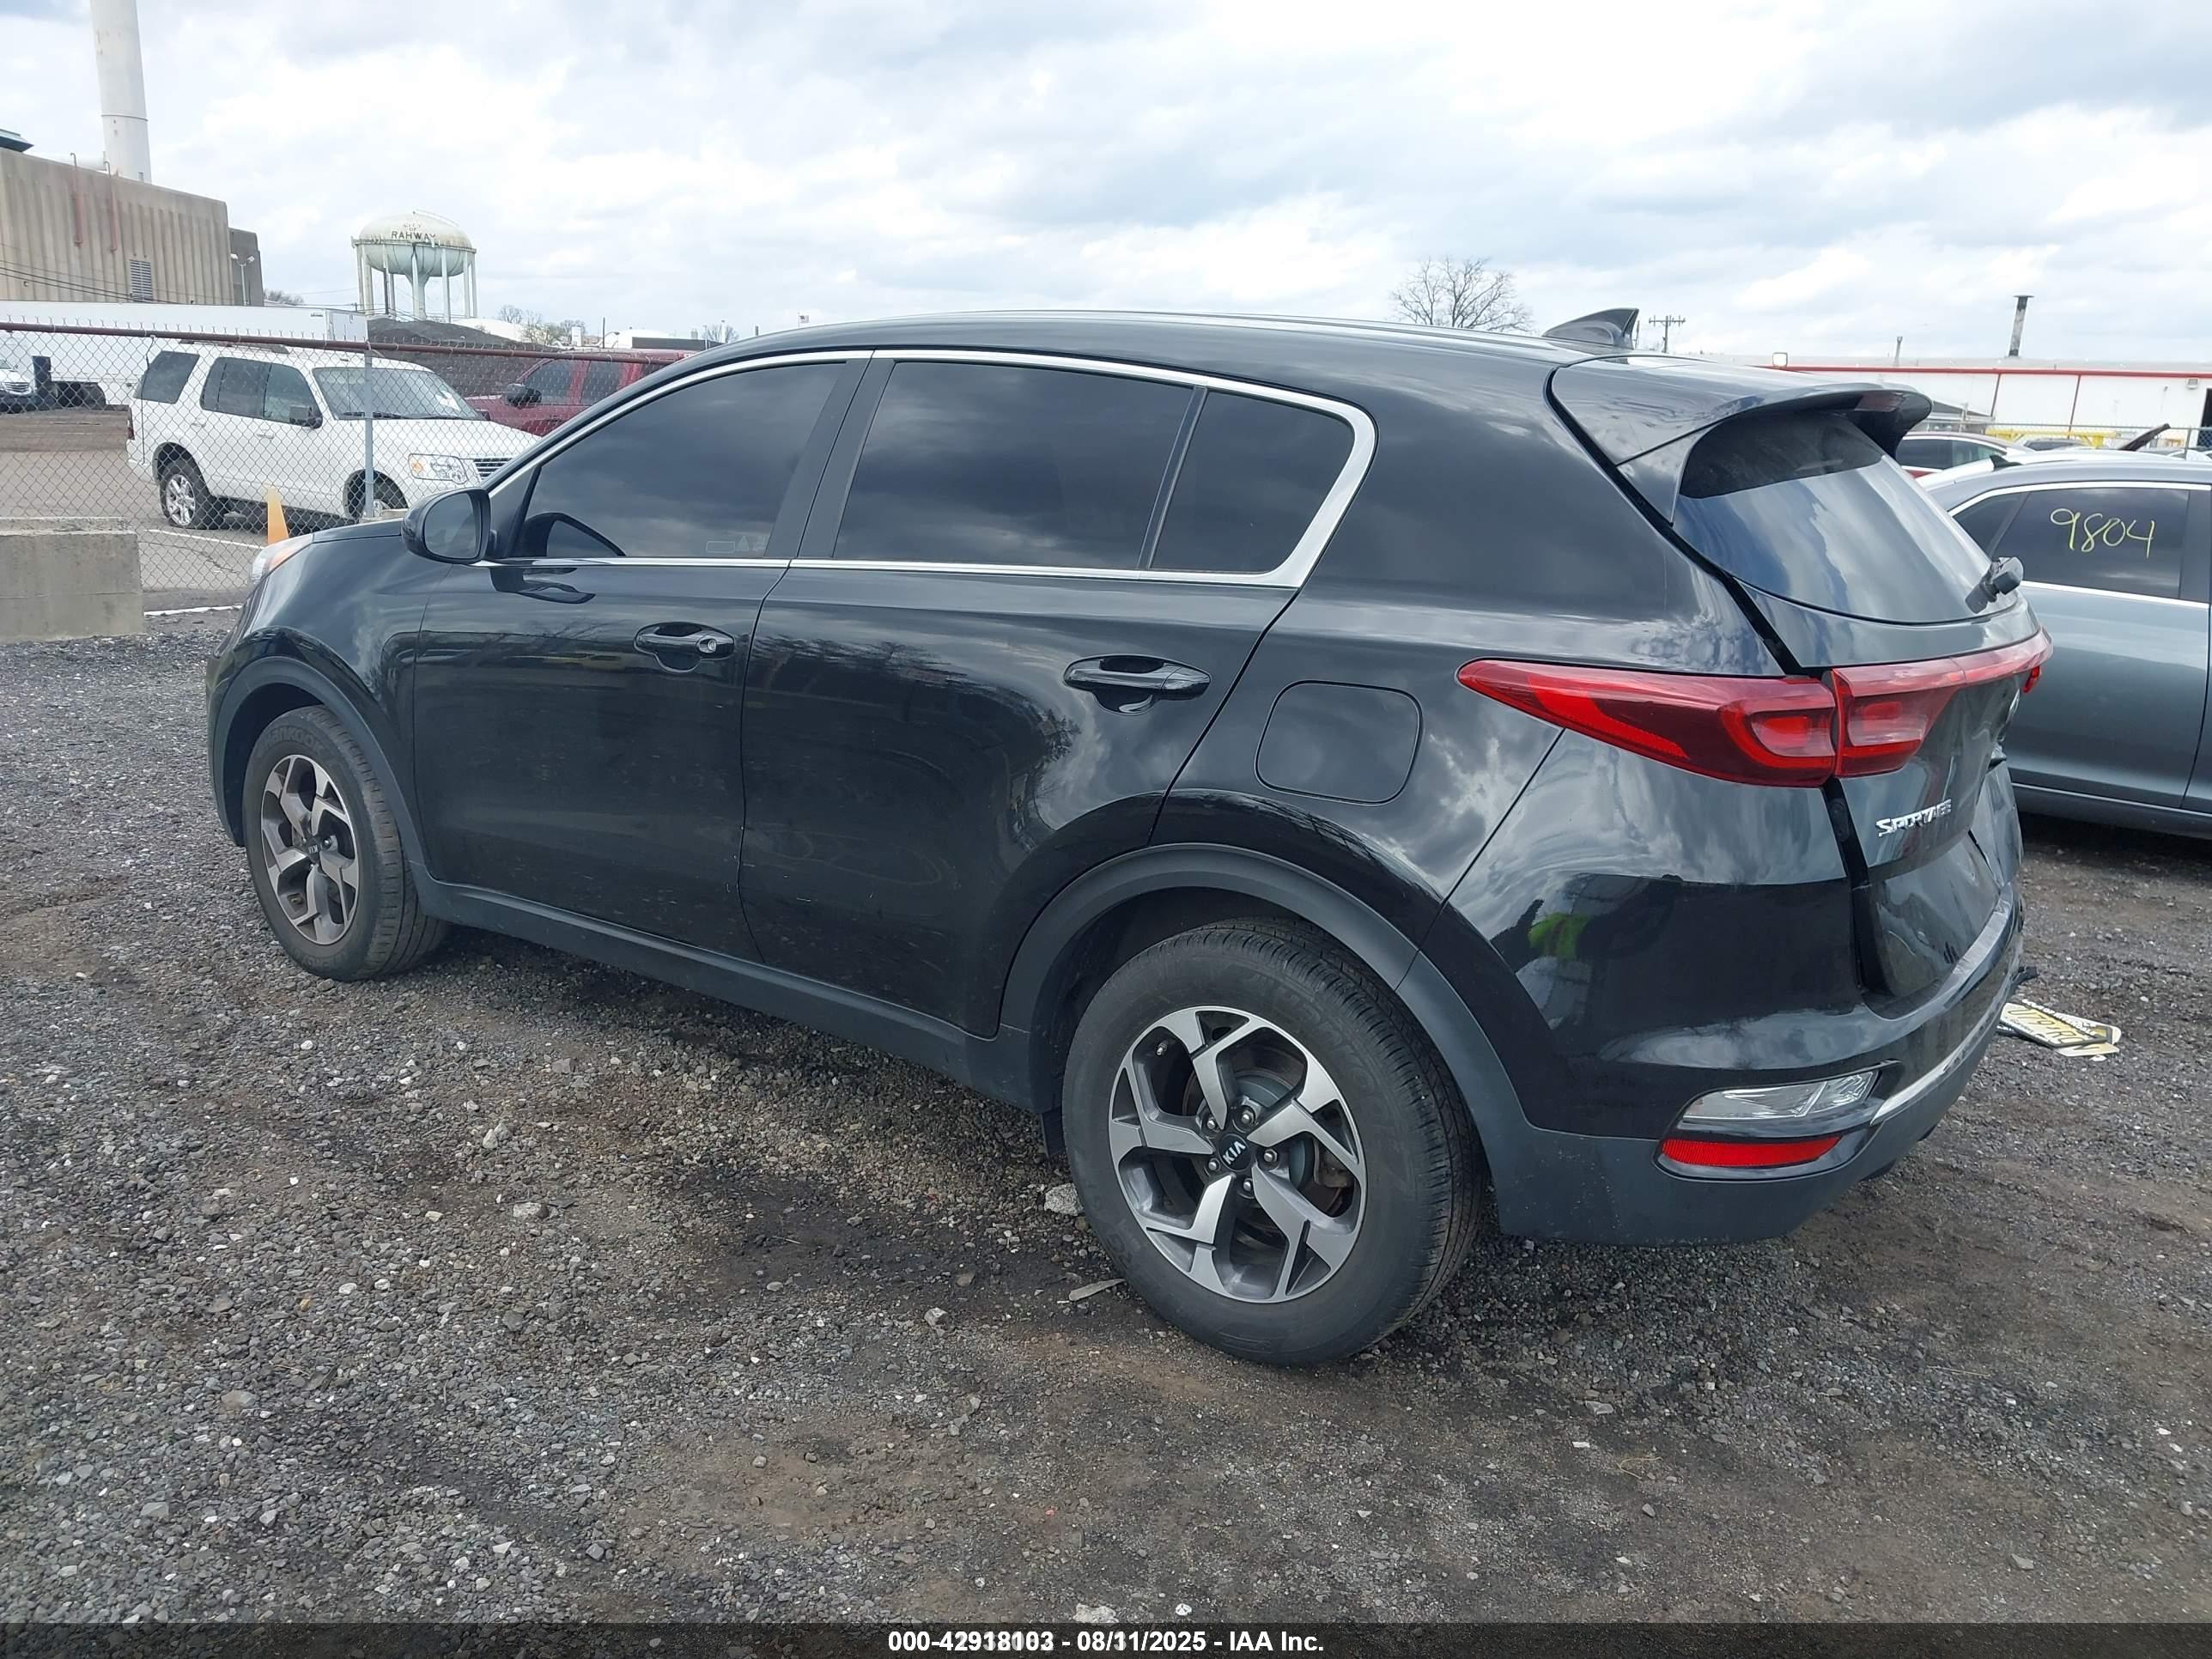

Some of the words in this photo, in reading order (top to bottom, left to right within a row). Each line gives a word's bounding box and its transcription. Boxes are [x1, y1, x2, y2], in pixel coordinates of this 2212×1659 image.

[391, 230, 436, 240] RAHWAY
[2050, 507, 2155, 559] 9804
[1875, 798, 1952, 838] SPORTAGE
[1222, 1140, 1247, 1166] KIA
